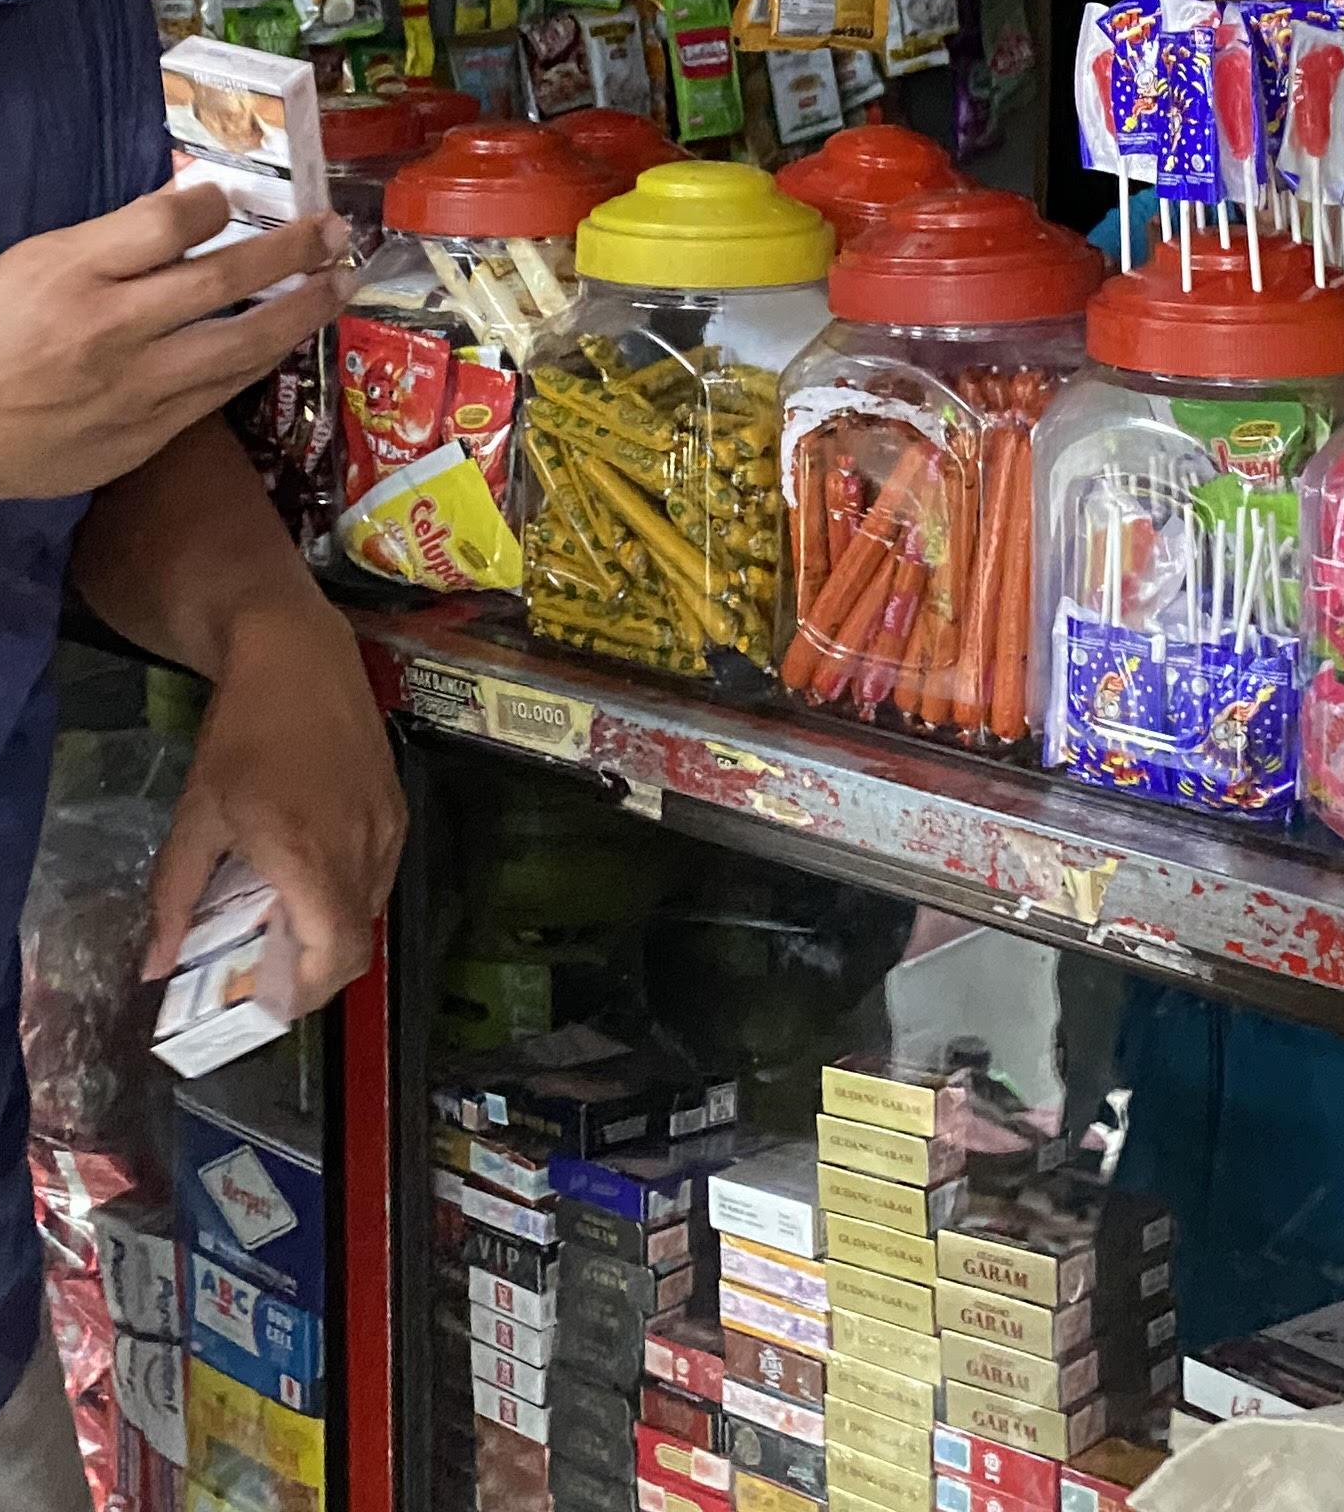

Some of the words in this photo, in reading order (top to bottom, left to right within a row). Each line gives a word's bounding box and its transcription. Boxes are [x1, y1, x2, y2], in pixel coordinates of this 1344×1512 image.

[510, 700, 565, 726] 10.000
[476, 1233, 521, 1266] VIP
[962, 1258, 1029, 1289] GARAM
[959, 1307, 1024, 1340] GARAM
[965, 1359, 1031, 1393] GARAM
[971, 1409, 1038, 1443] GARAM
